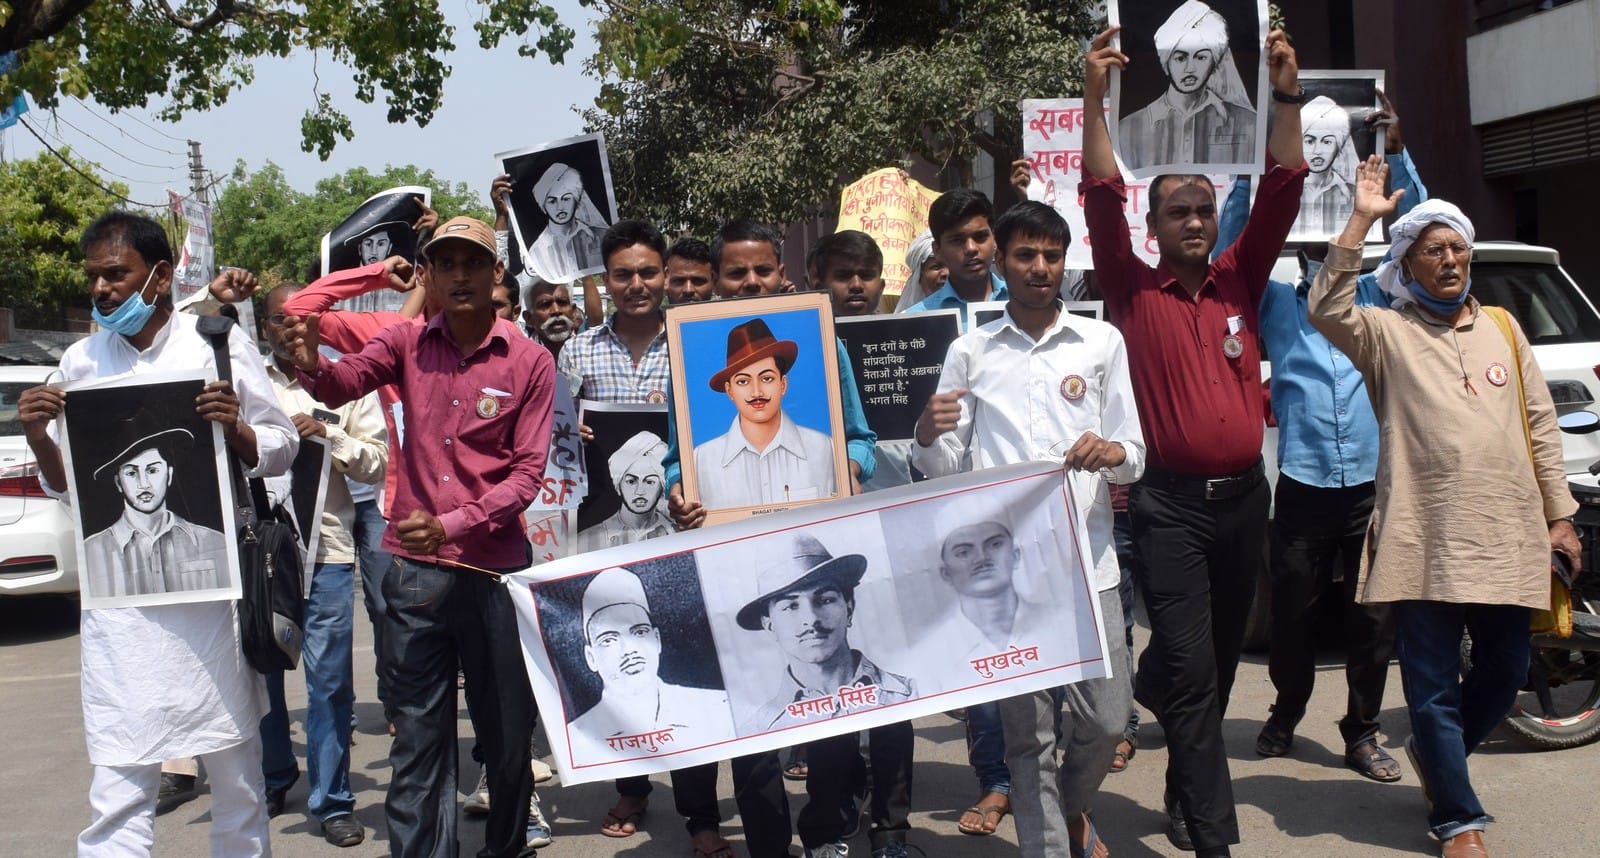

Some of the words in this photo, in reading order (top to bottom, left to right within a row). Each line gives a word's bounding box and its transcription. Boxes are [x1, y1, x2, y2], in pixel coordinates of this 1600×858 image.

[880, 340, 897, 352] दंगों
[898, 340, 908, 350] के
[910, 338, 926, 349] पीछे
[863, 354, 905, 366] सांप्रदायिक
[892, 366, 909, 377] और
[864, 384, 876, 392] का
[878, 382, 895, 392] हाथ
[892, 392, 909, 405] सिंह
[970, 645, 1039, 678] सुखदेव
[787, 696, 834, 717] भगत
[838, 682, 877, 708] सिंह
